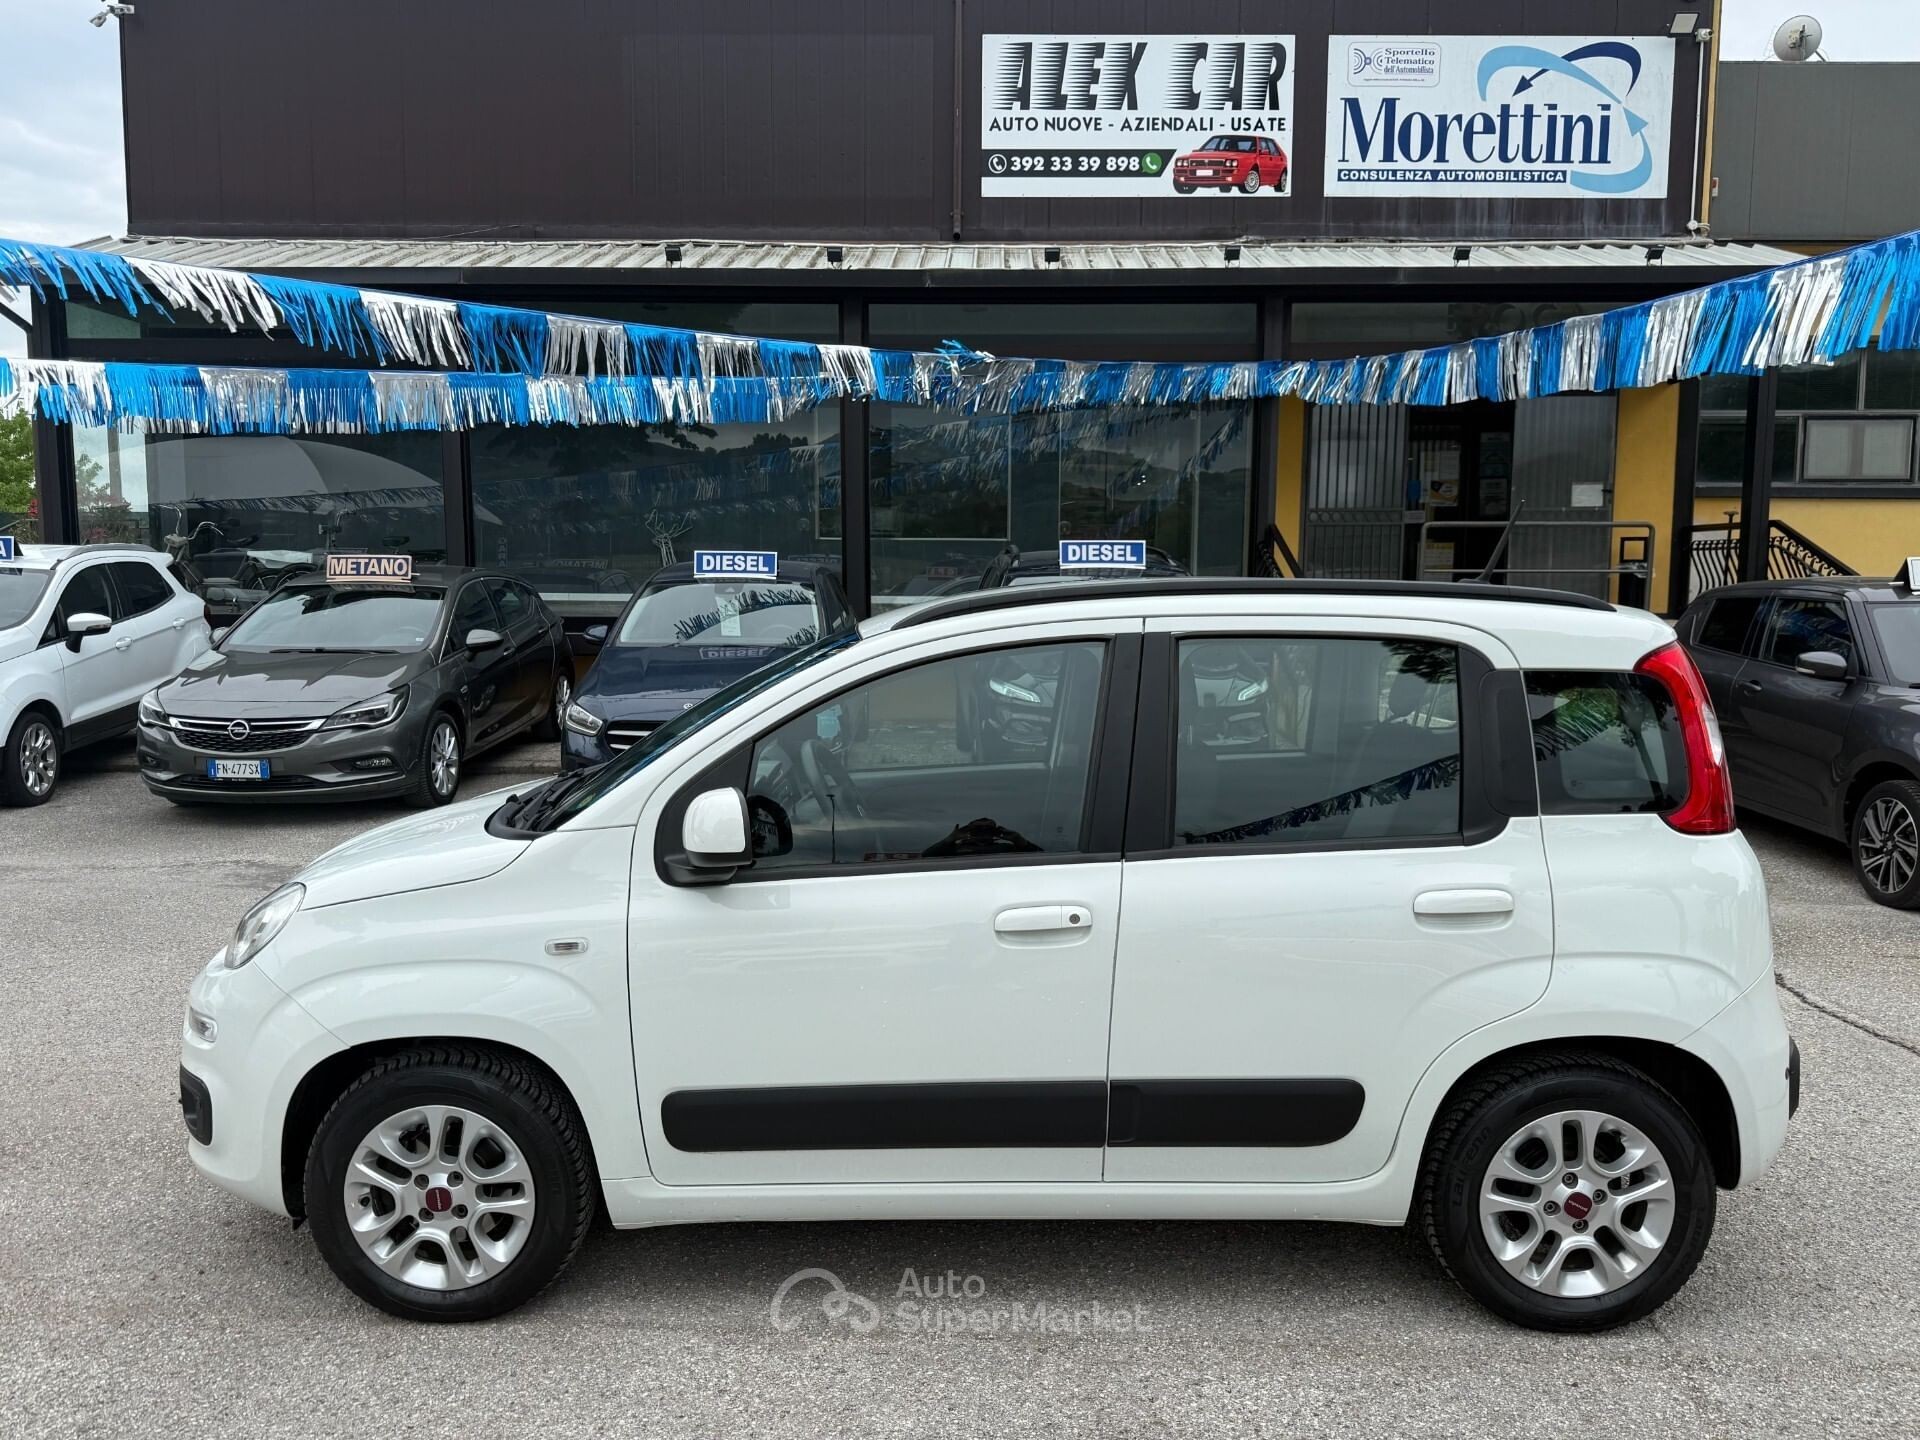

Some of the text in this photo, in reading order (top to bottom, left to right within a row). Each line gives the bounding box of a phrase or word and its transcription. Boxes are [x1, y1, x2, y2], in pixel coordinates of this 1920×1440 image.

[1384, 48, 1435, 57] Sportello
[1384, 57, 1435, 65] Telematico
[992, 42, 1287, 111] ALEX CAR
[989, 117, 1039, 131] AUTO
[1044, 117, 1102, 132] NUOVE
[1120, 117, 1213, 132] AZIENDALI
[1231, 117, 1286, 132] USATE
[1338, 97, 1612, 165] Morettini
[1010, 156, 1140, 171] 392 33 39 898
[1340, 170, 1564, 182] CONSULENZA AUTOMOBILISTICA
[1067, 544, 1137, 561] DIESEL
[330, 558, 408, 575] METANO
[702, 554, 769, 571] DIESEL
